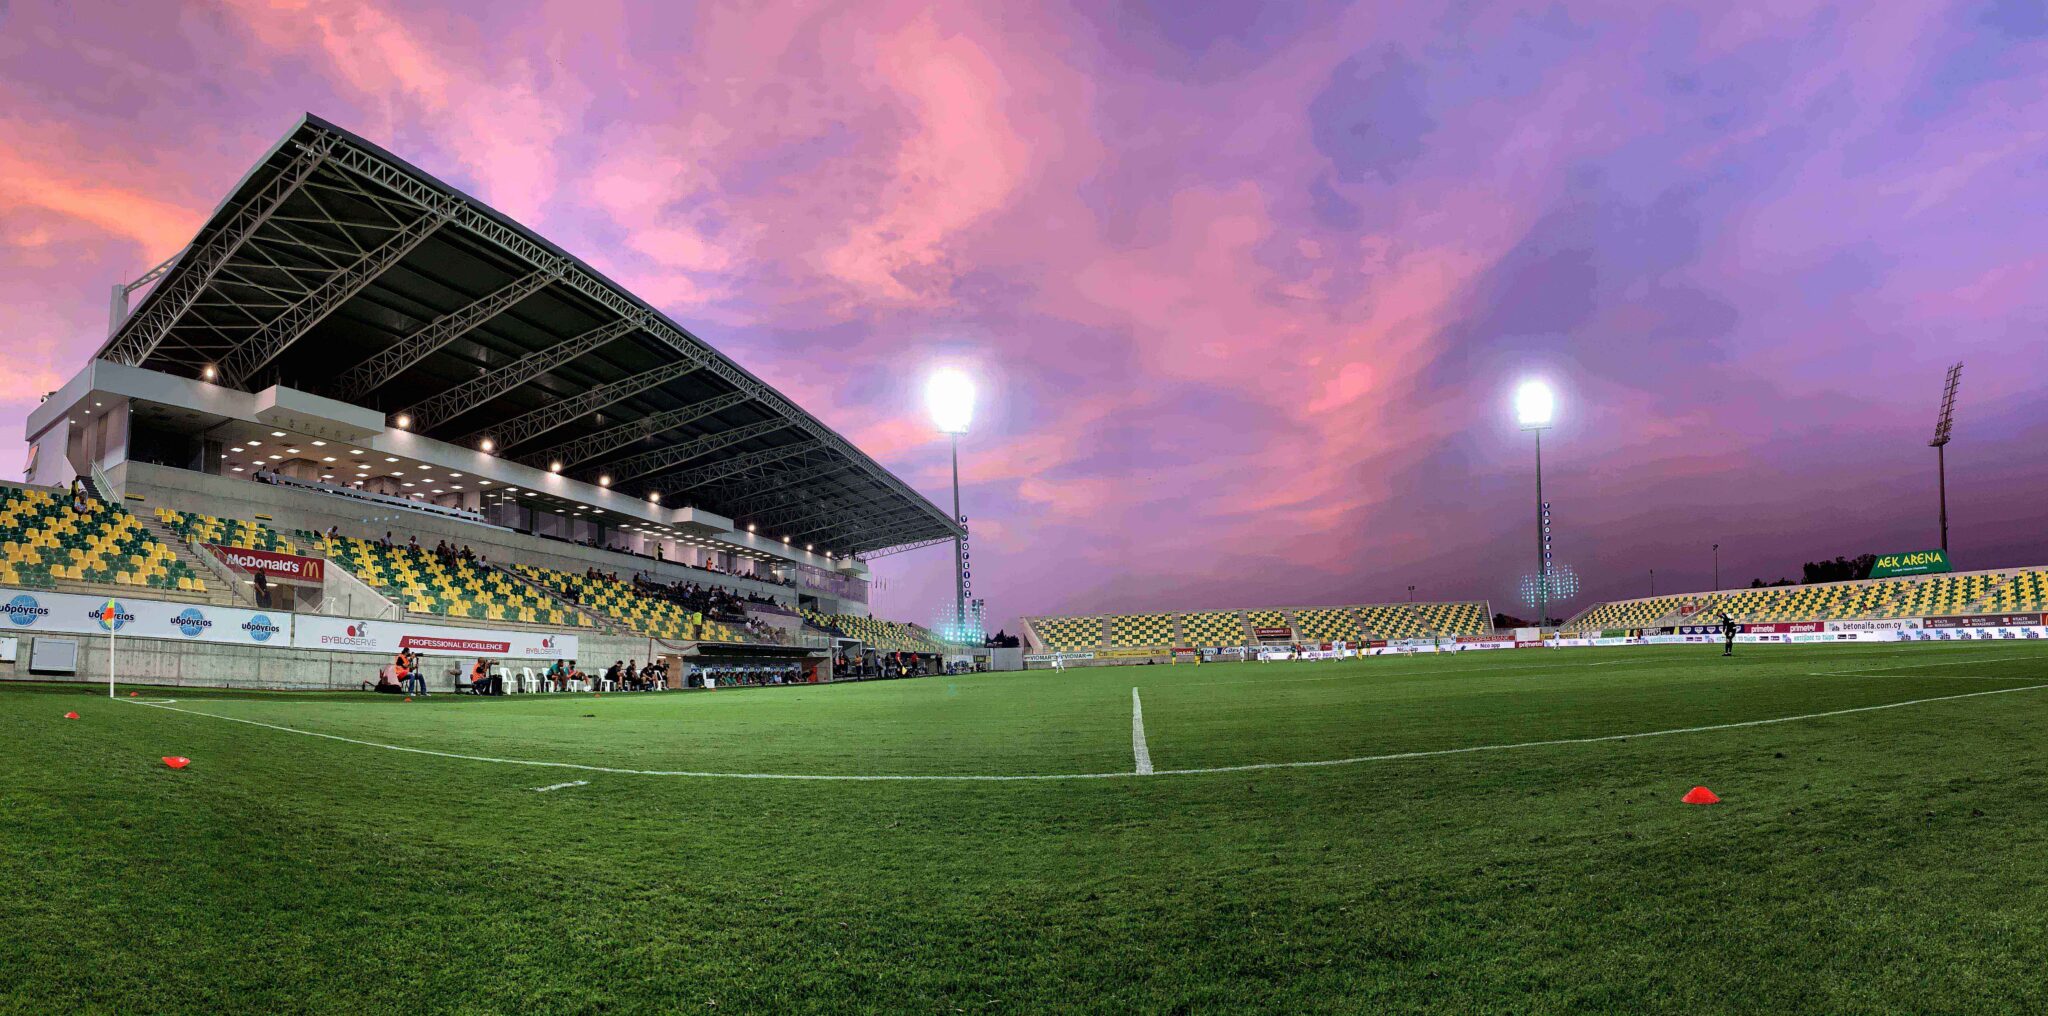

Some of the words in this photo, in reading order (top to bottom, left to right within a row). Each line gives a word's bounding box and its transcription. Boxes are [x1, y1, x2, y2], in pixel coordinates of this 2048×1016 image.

[226, 553, 299, 573] McDonald's
[1877, 556, 1900, 568] AEK
[1902, 552, 1942, 566] ARENA
[0, 603, 49, 616] υδρόγειος
[88, 609, 135, 621] υδρειος
[170, 616, 212, 628] υδρόγειος
[241, 622, 280, 632] υδρόγειος
[1790, 623, 1816, 632] primetel
[1843, 621, 1901, 630] betonalfa.com.cy
[1751, 625, 1775, 633] primetel
[321, 636, 376, 646] BYBLOSERVE
[408, 638, 462, 649] PROFESSIONAL
[462, 642, 503, 651] EXCELLENCE
[526, 648, 562, 656] BYBLOSERVE
